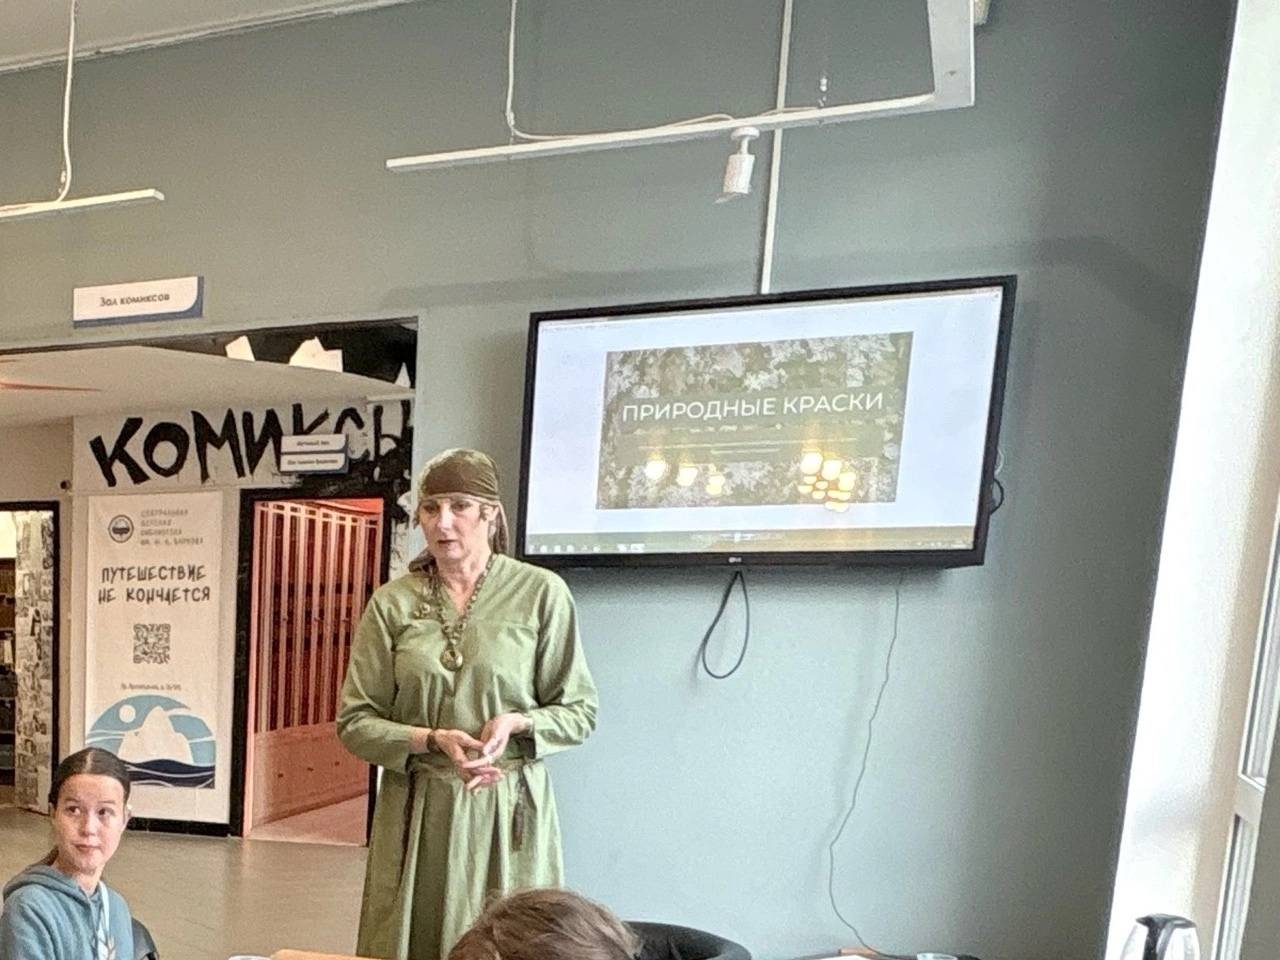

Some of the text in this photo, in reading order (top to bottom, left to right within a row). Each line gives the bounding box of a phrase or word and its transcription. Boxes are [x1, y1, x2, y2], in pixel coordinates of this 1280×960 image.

[622, 391, 883, 422] ПРИРОДНЫЕ КРАСКИ
[101, 563, 207, 585] ПУТЕШЕСТВИЕ
[98, 585, 211, 606] НЕ КОНЧАЕТСЯ
